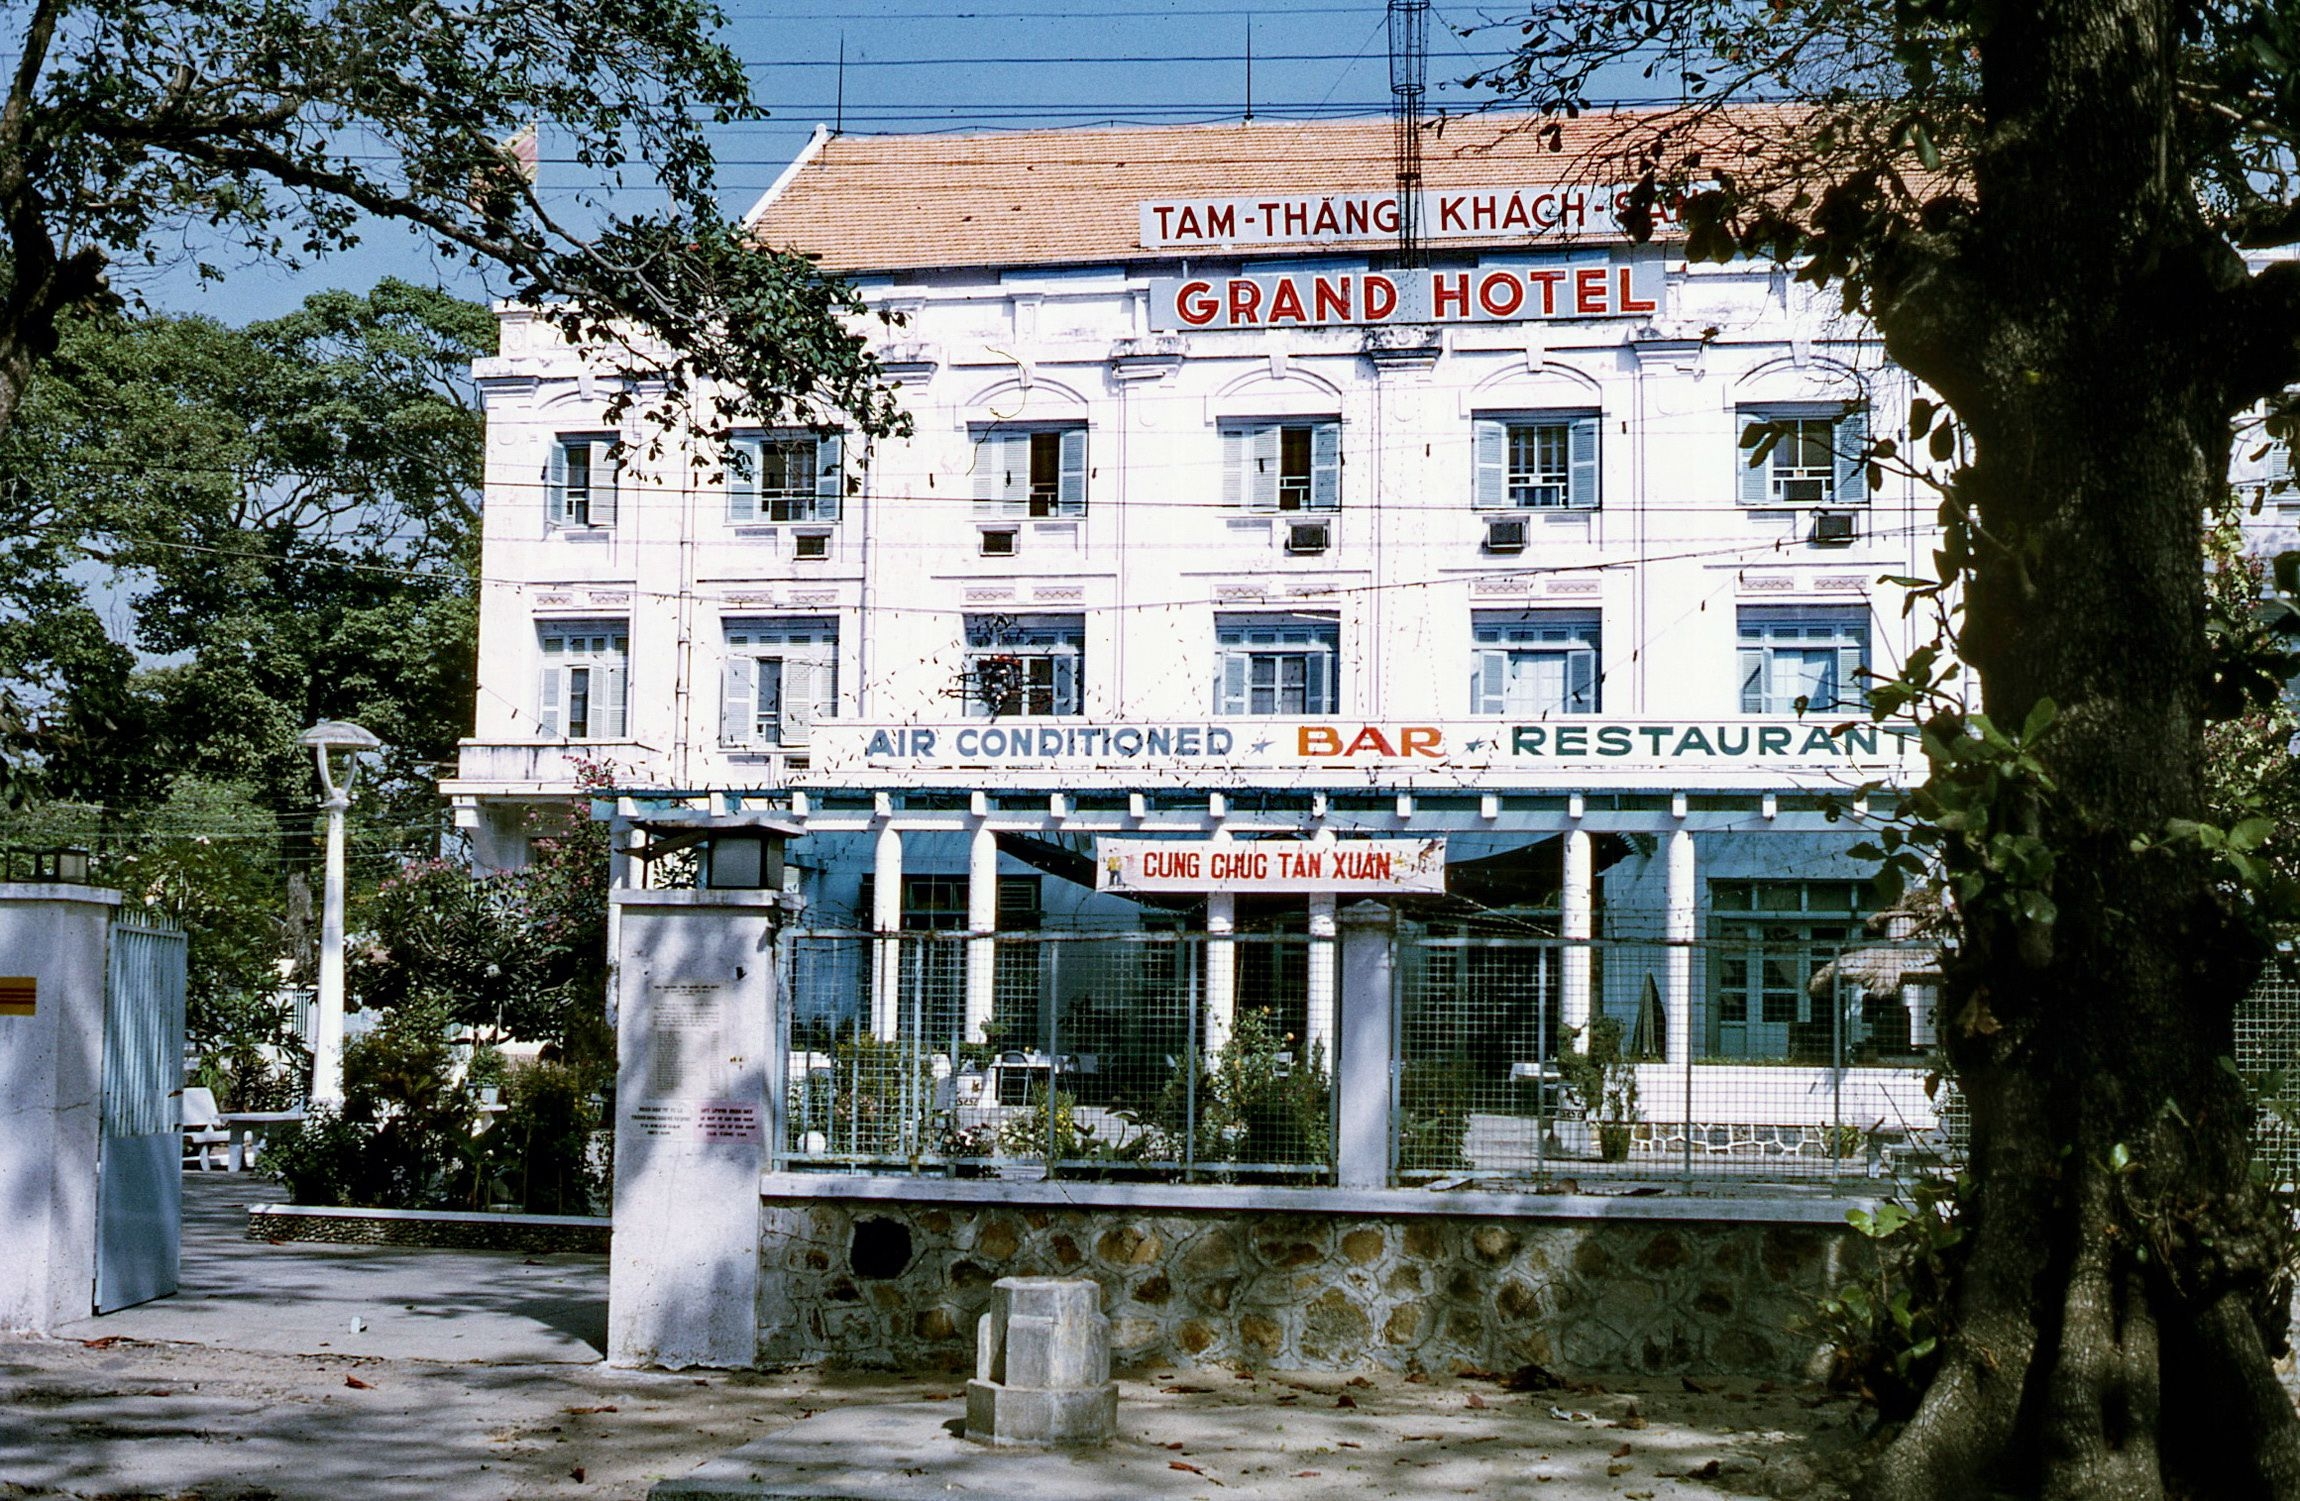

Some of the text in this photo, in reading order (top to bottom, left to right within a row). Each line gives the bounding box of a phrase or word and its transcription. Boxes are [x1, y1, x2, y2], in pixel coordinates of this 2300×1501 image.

[1175, 267, 1657, 326] GRAND HOTEL
[866, 725, 1921, 758] AIR CONDITIONED BAR RESTAURANT
[1143, 852, 1200, 878] CUNG
